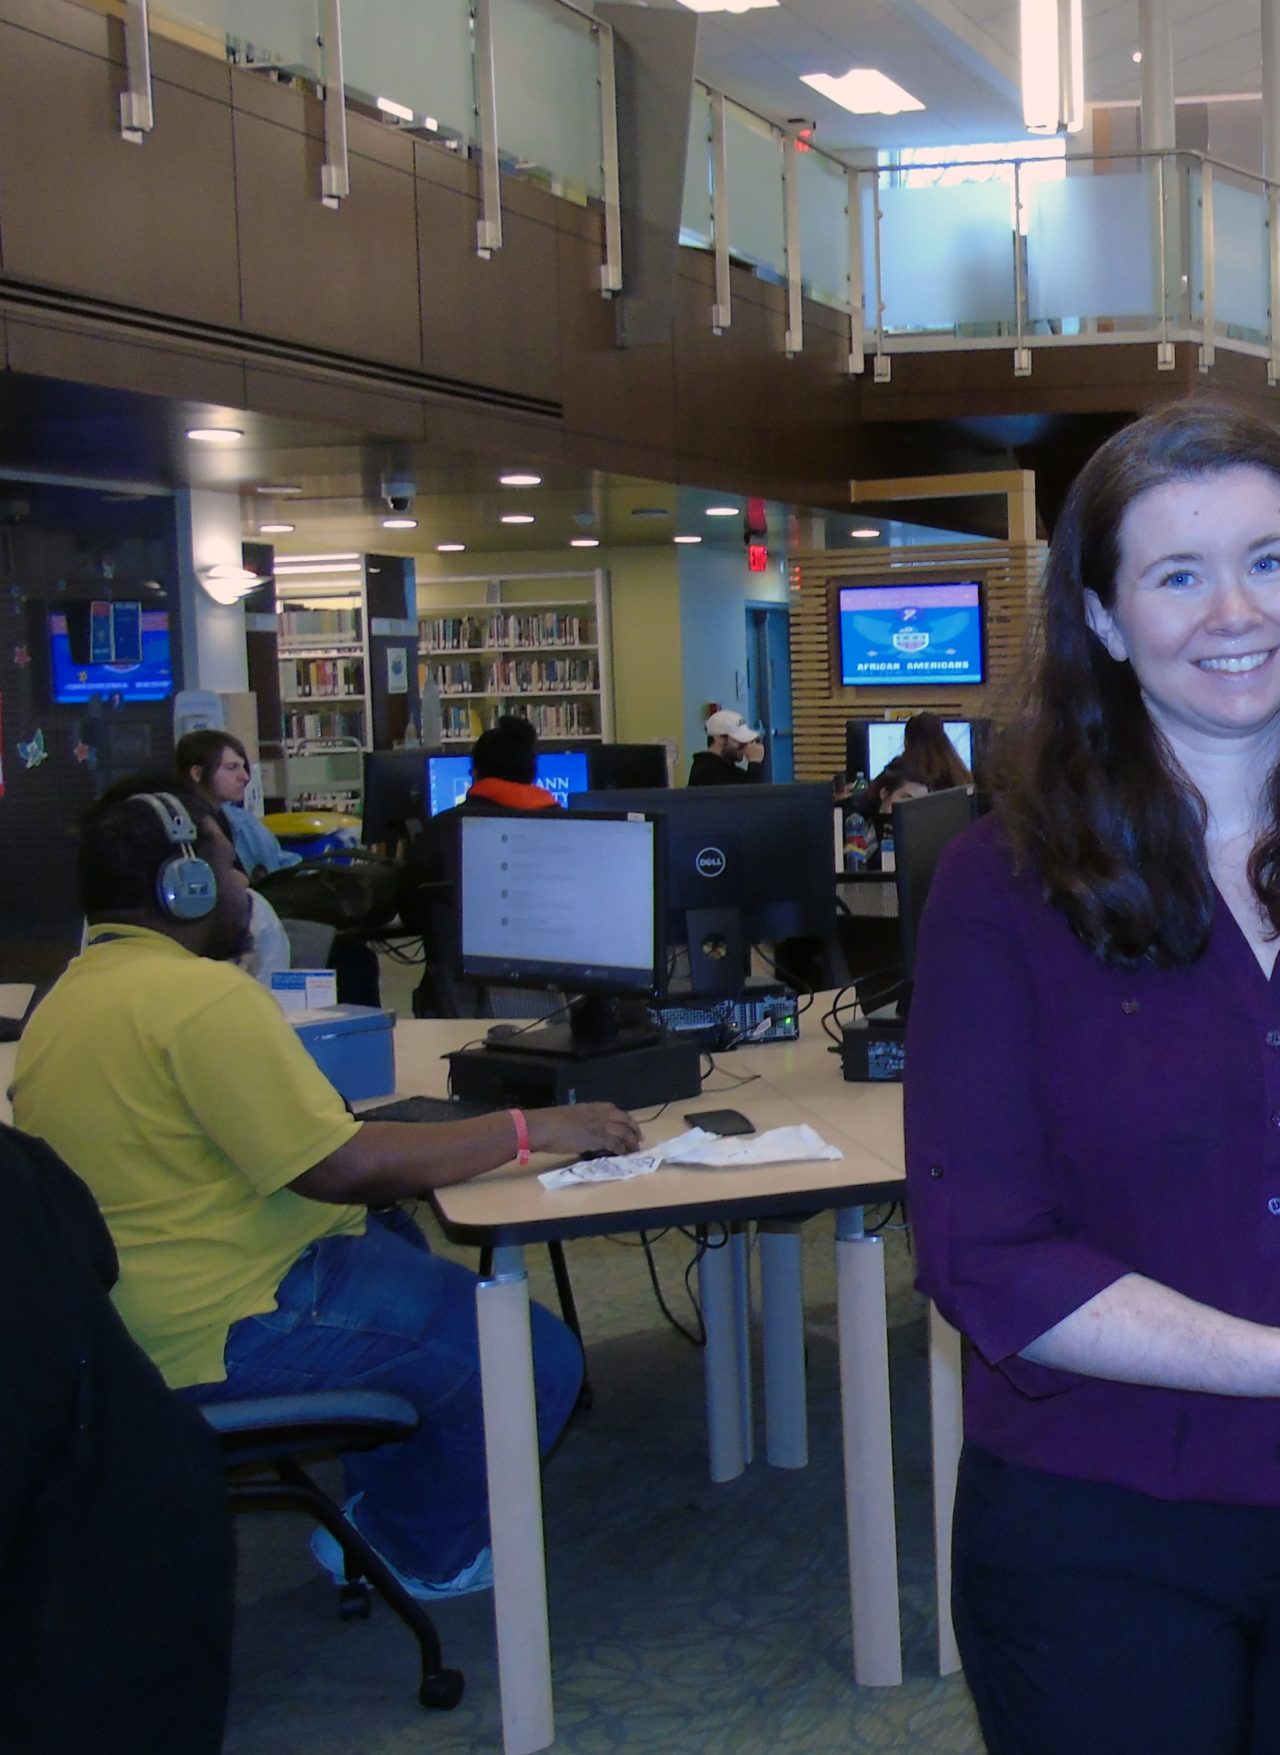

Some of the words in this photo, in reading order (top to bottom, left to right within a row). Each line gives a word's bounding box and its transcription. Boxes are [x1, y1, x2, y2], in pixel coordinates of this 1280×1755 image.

[857, 662, 900, 671] AFRICAN
[907, 660, 969, 670] AMERICANS
[700, 858, 722, 866] DELL
